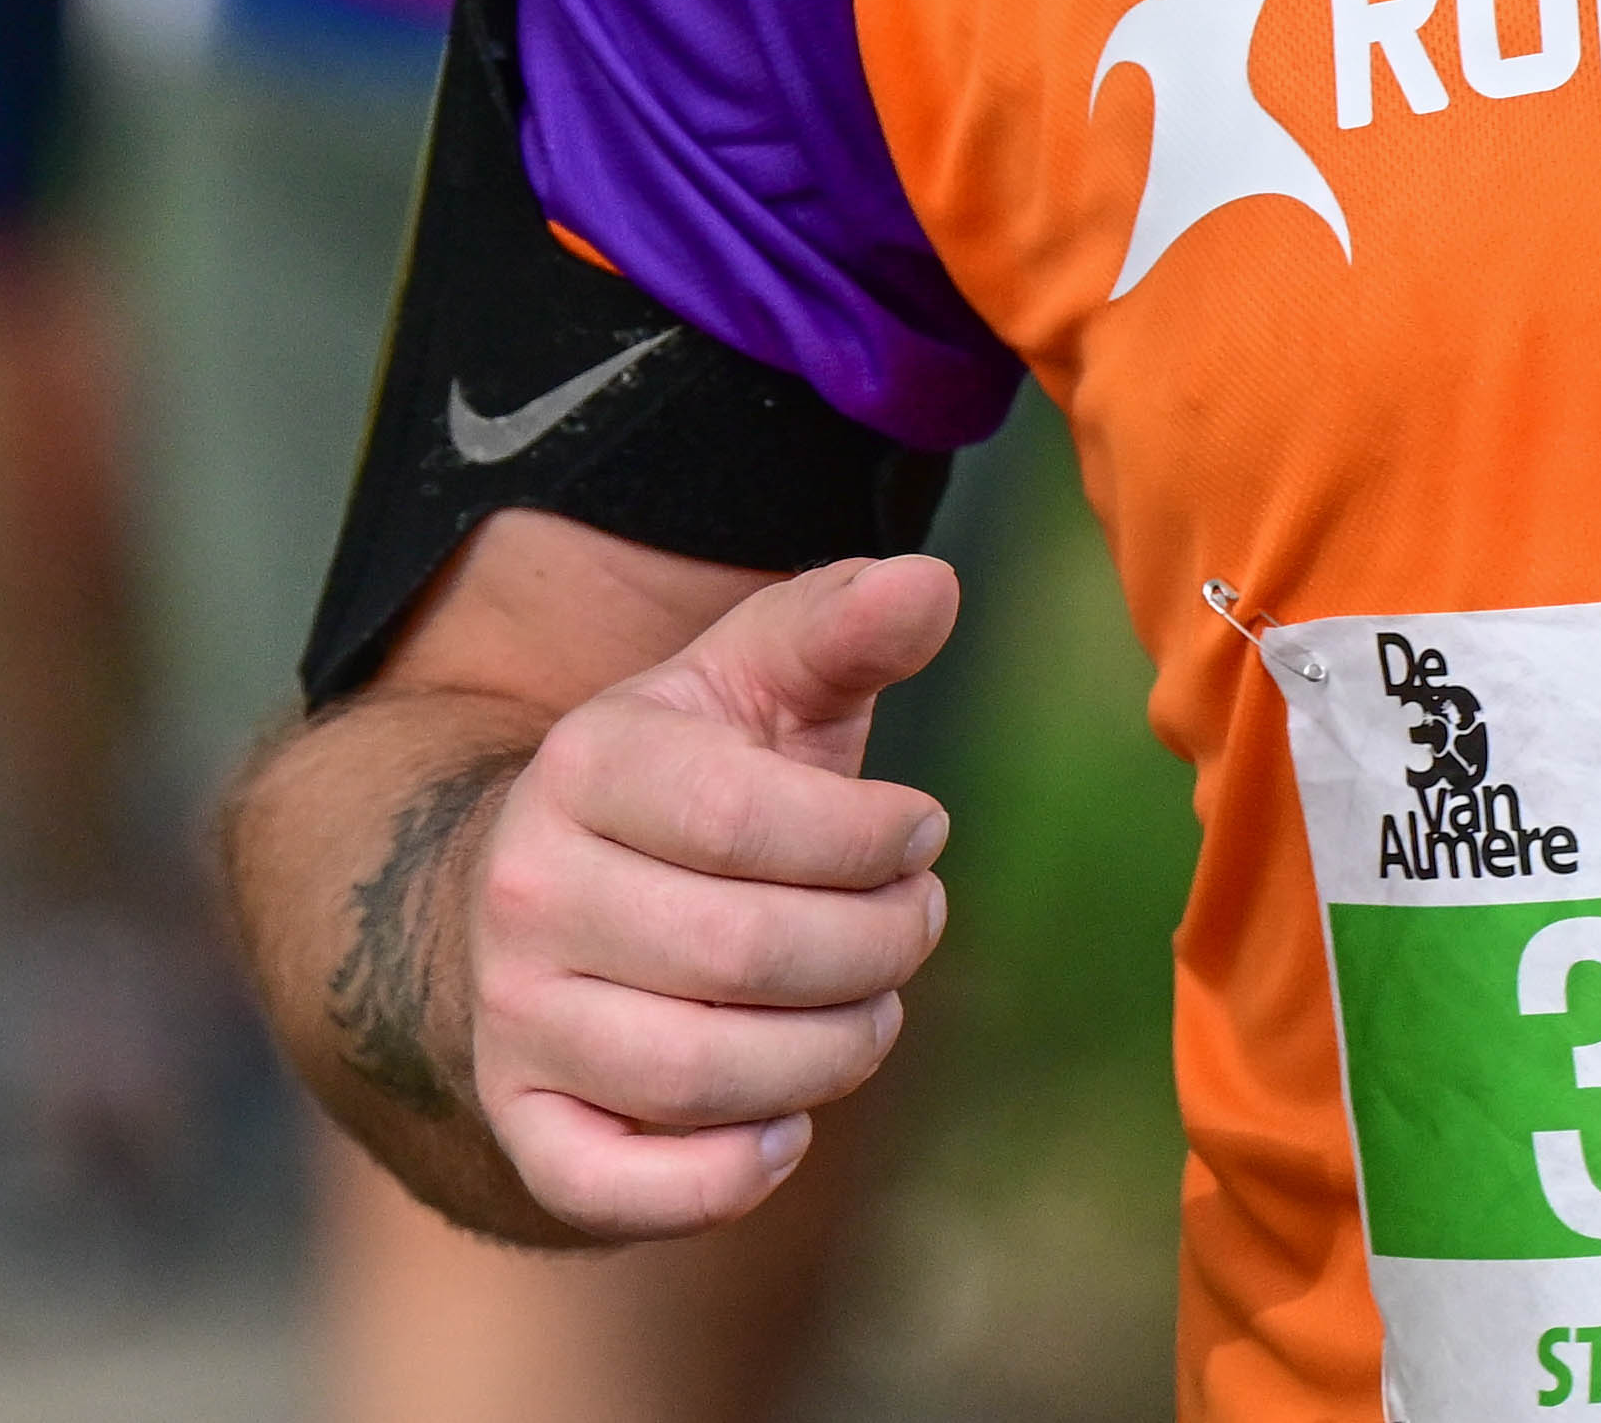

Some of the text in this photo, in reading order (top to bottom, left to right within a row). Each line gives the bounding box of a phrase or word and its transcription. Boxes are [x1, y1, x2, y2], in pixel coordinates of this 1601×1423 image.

[1376, 632, 1448, 696] De
[1416, 783, 1521, 834] van
[1379, 810, 1579, 881] Almere
